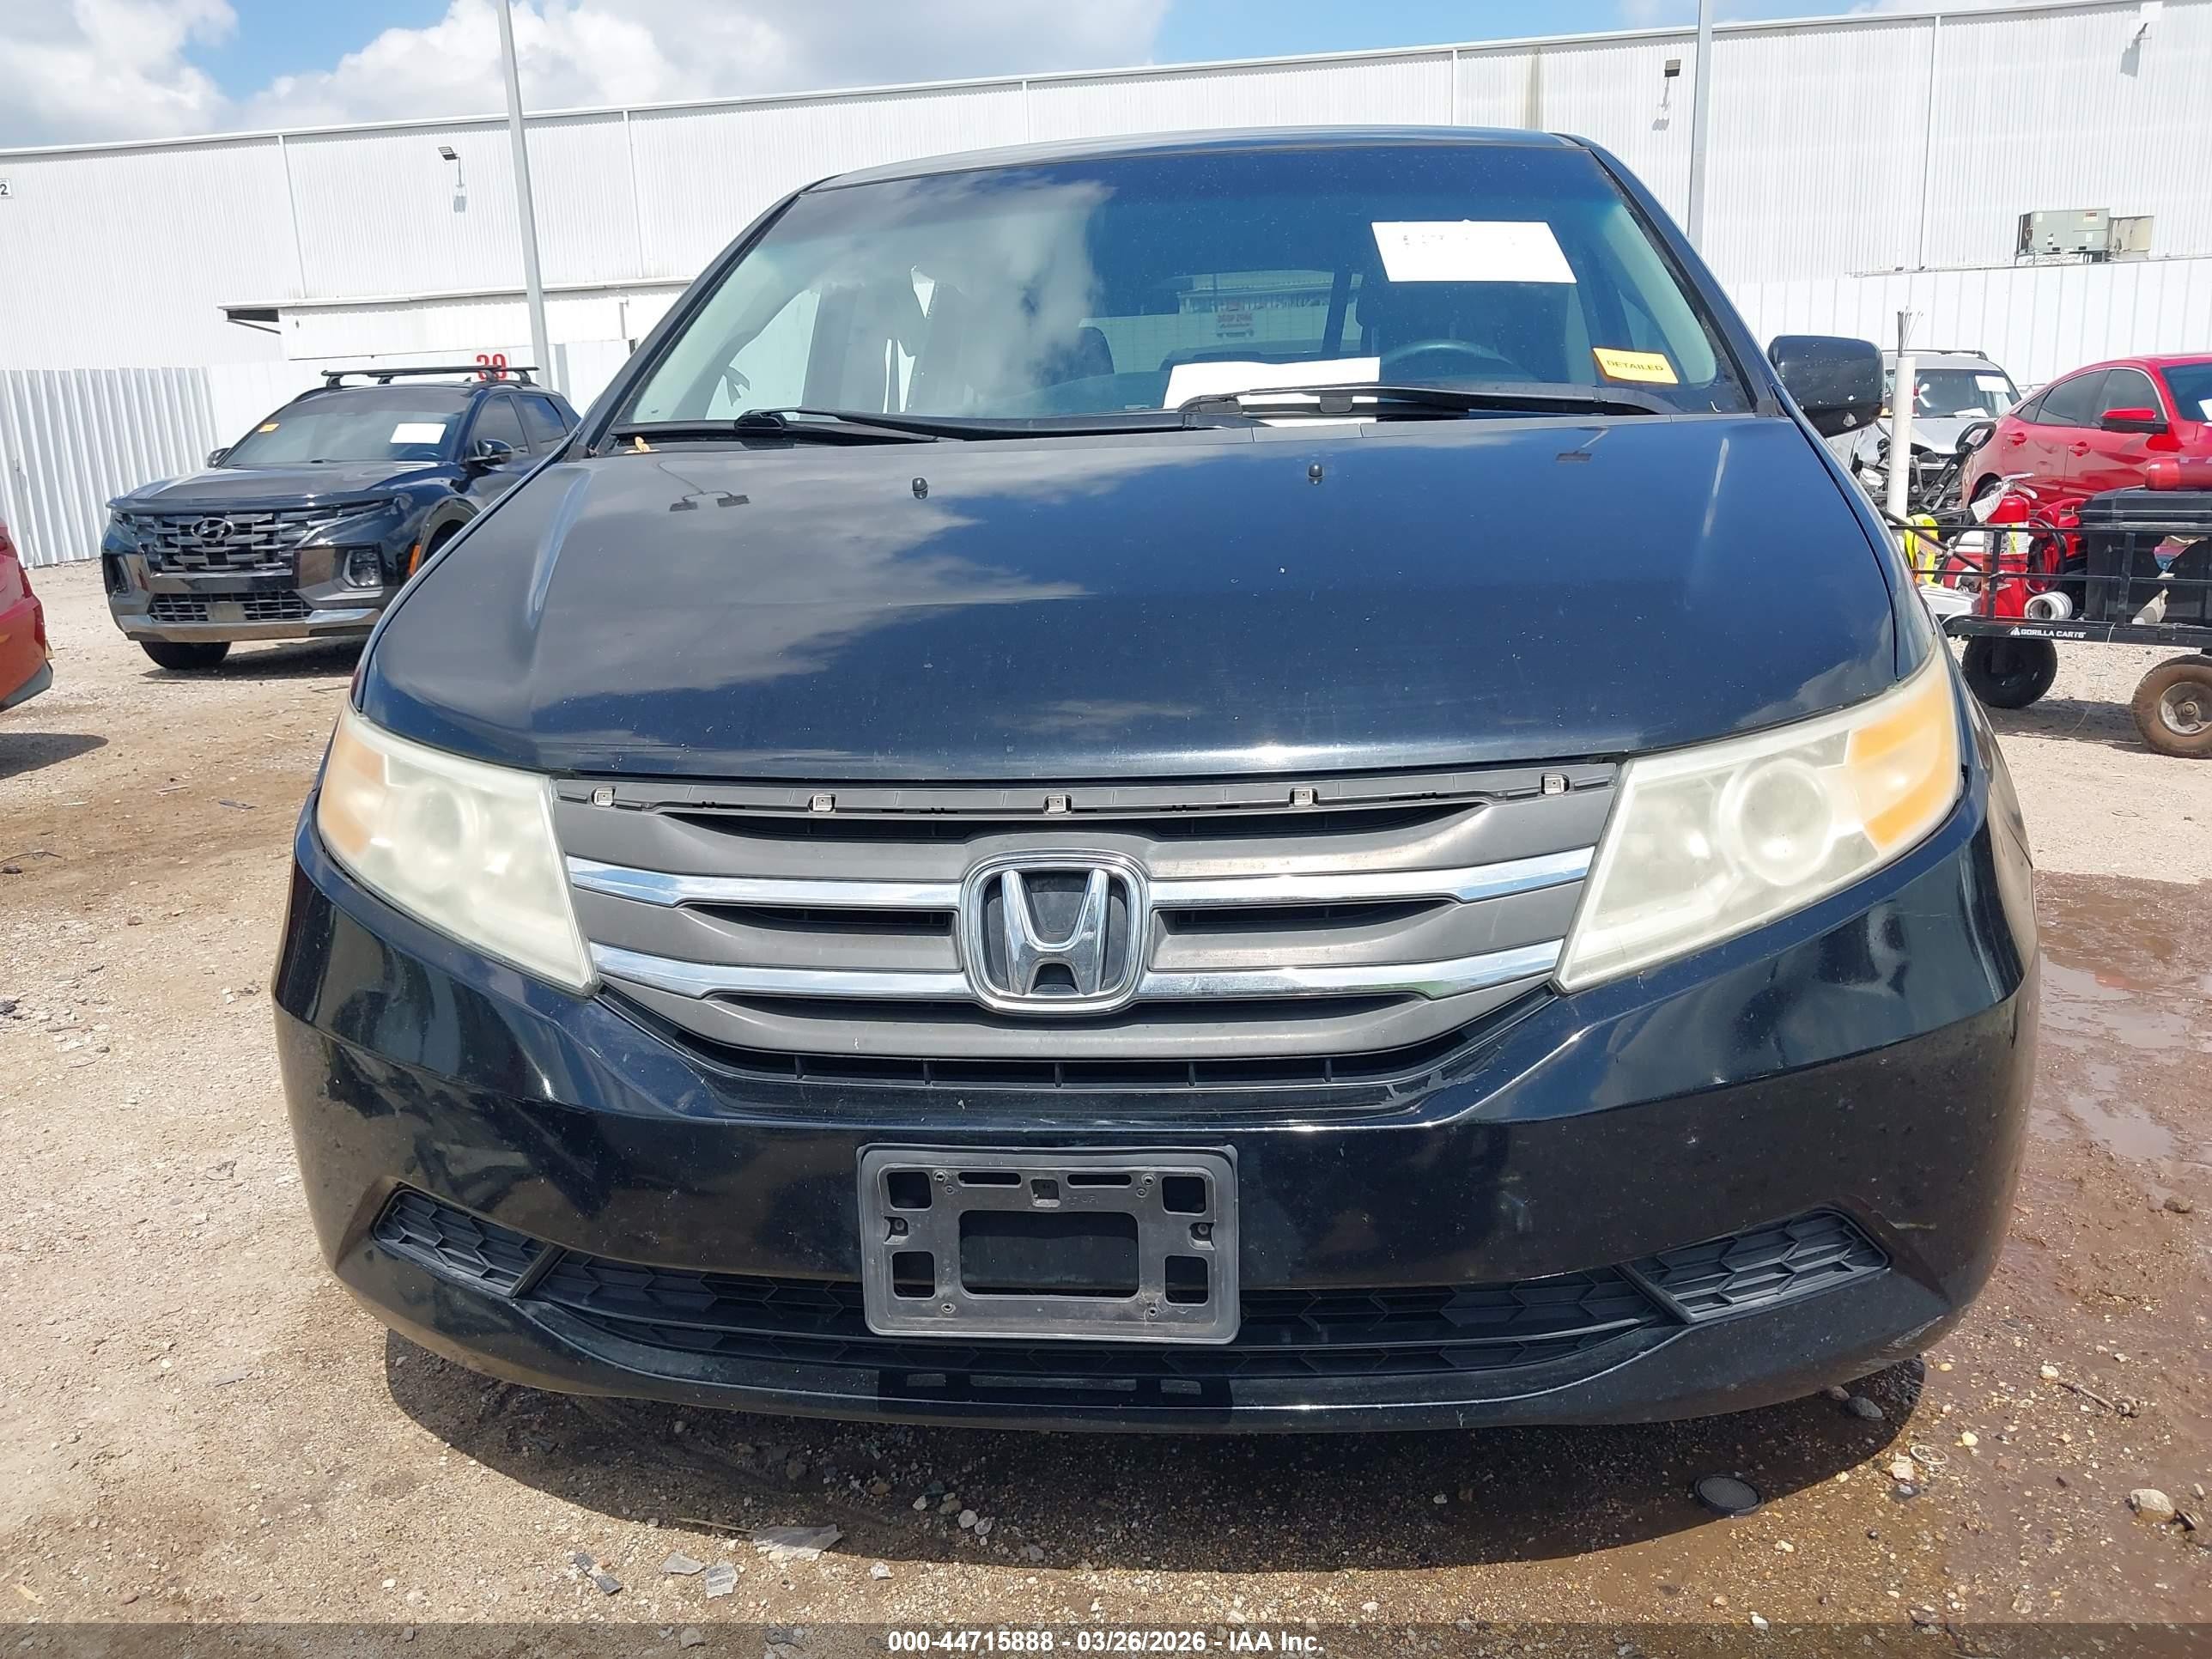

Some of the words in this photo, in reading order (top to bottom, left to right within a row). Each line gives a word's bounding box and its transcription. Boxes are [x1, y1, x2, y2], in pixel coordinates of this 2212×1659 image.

[1606, 359, 1664, 371] DETAILED
[2021, 628, 2055, 637] GORILLA
[2056, 630, 2085, 639] CARTS
